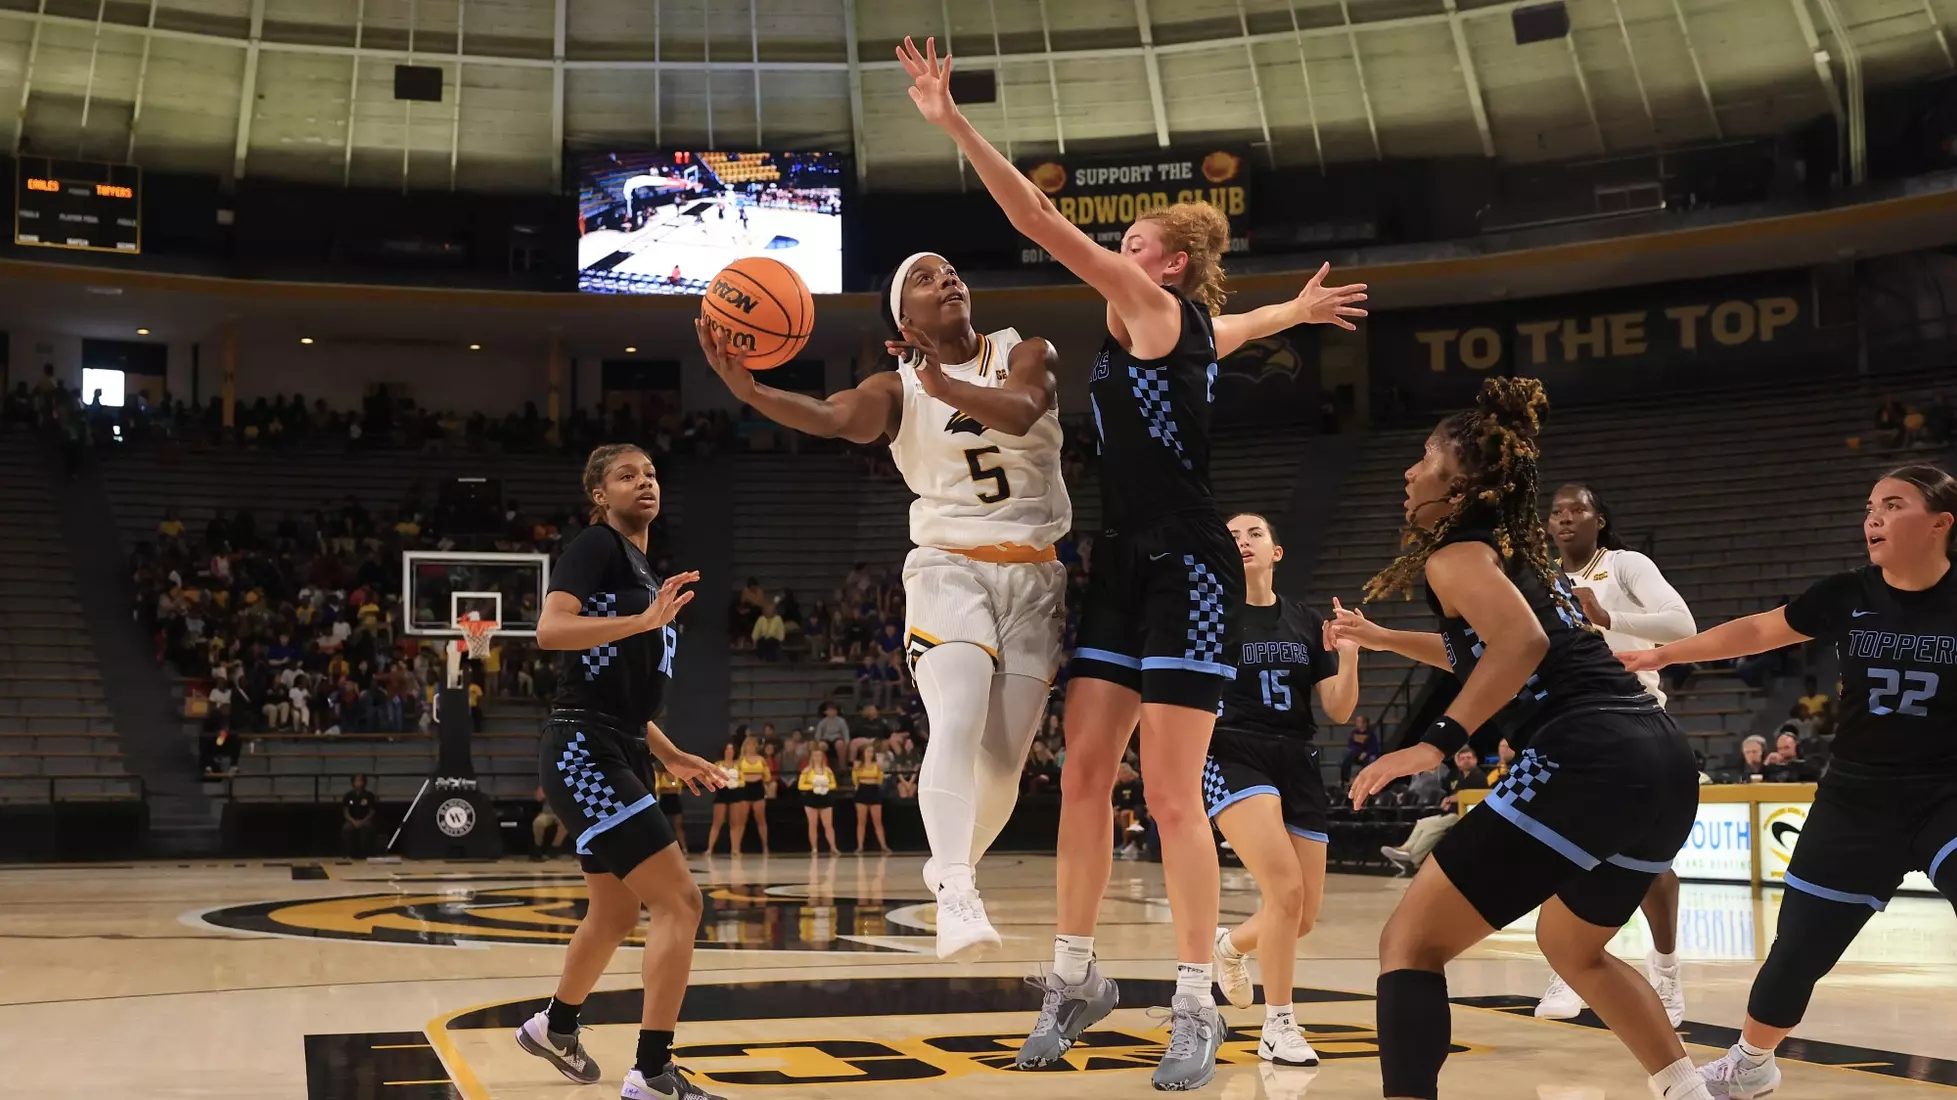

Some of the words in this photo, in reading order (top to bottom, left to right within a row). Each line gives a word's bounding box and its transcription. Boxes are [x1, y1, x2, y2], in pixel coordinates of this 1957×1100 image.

[1075, 164, 1152, 186] SUPPORT
[1157, 161, 1193, 181] THE
[1053, 192, 1169, 225] RDWOOD
[712, 279, 758, 314] NCAA
[1415, 327, 1501, 371] TO
[1516, 311, 1649, 364] THE
[1664, 297, 1799, 349] TOP
[963, 445, 1011, 504] 5
[1242, 641, 1310, 665] OPPERS
[1848, 629, 1957, 665] TOPPER
[1258, 669, 1292, 711] 15
[1867, 667, 1940, 717] 22
[1682, 820, 1750, 850] OUTH
